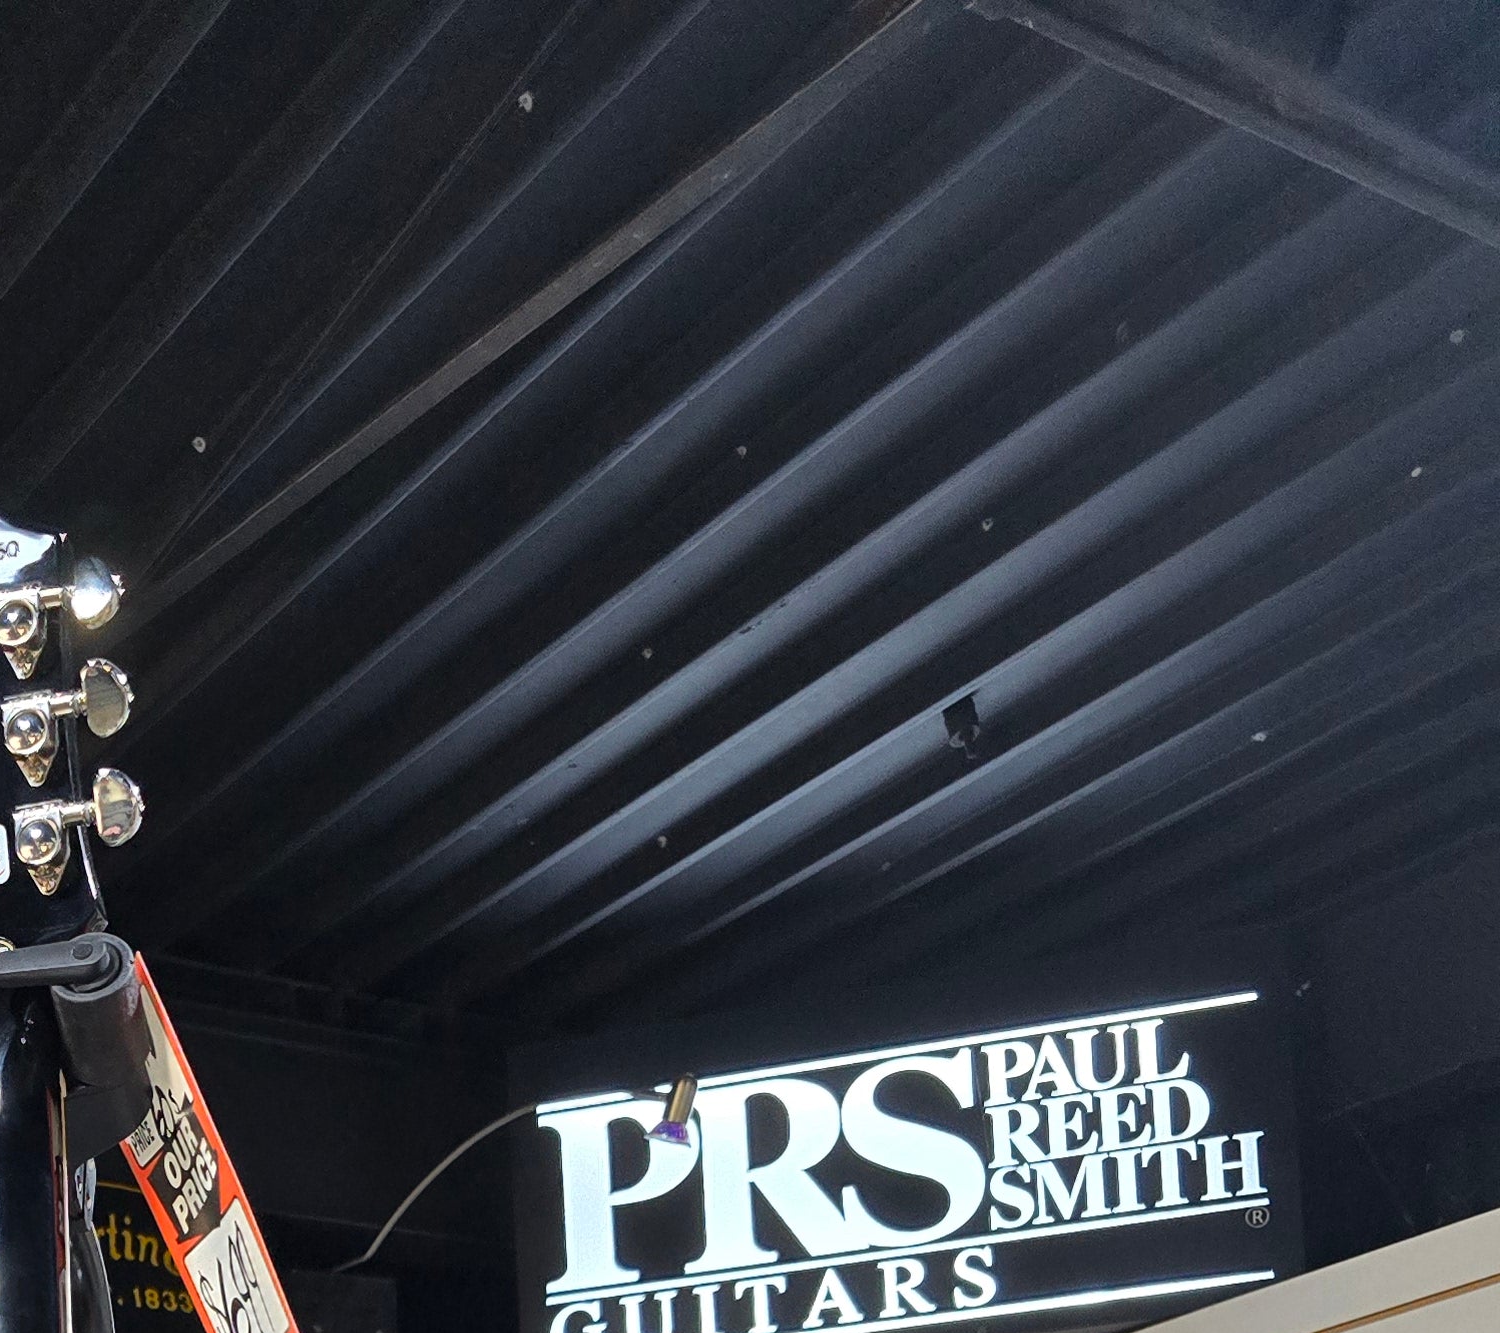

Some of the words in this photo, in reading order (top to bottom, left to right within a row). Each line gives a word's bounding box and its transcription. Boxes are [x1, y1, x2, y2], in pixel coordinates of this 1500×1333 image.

[980, 1018, 1190, 1108] PAUL
[163, 1116, 199, 1190] OUR
[985, 1078, 1212, 1168] REED
[171, 1137, 218, 1235] PRICE
[537, 1046, 986, 1296] PRS
[989, 1130, 1268, 1232] SMITH
